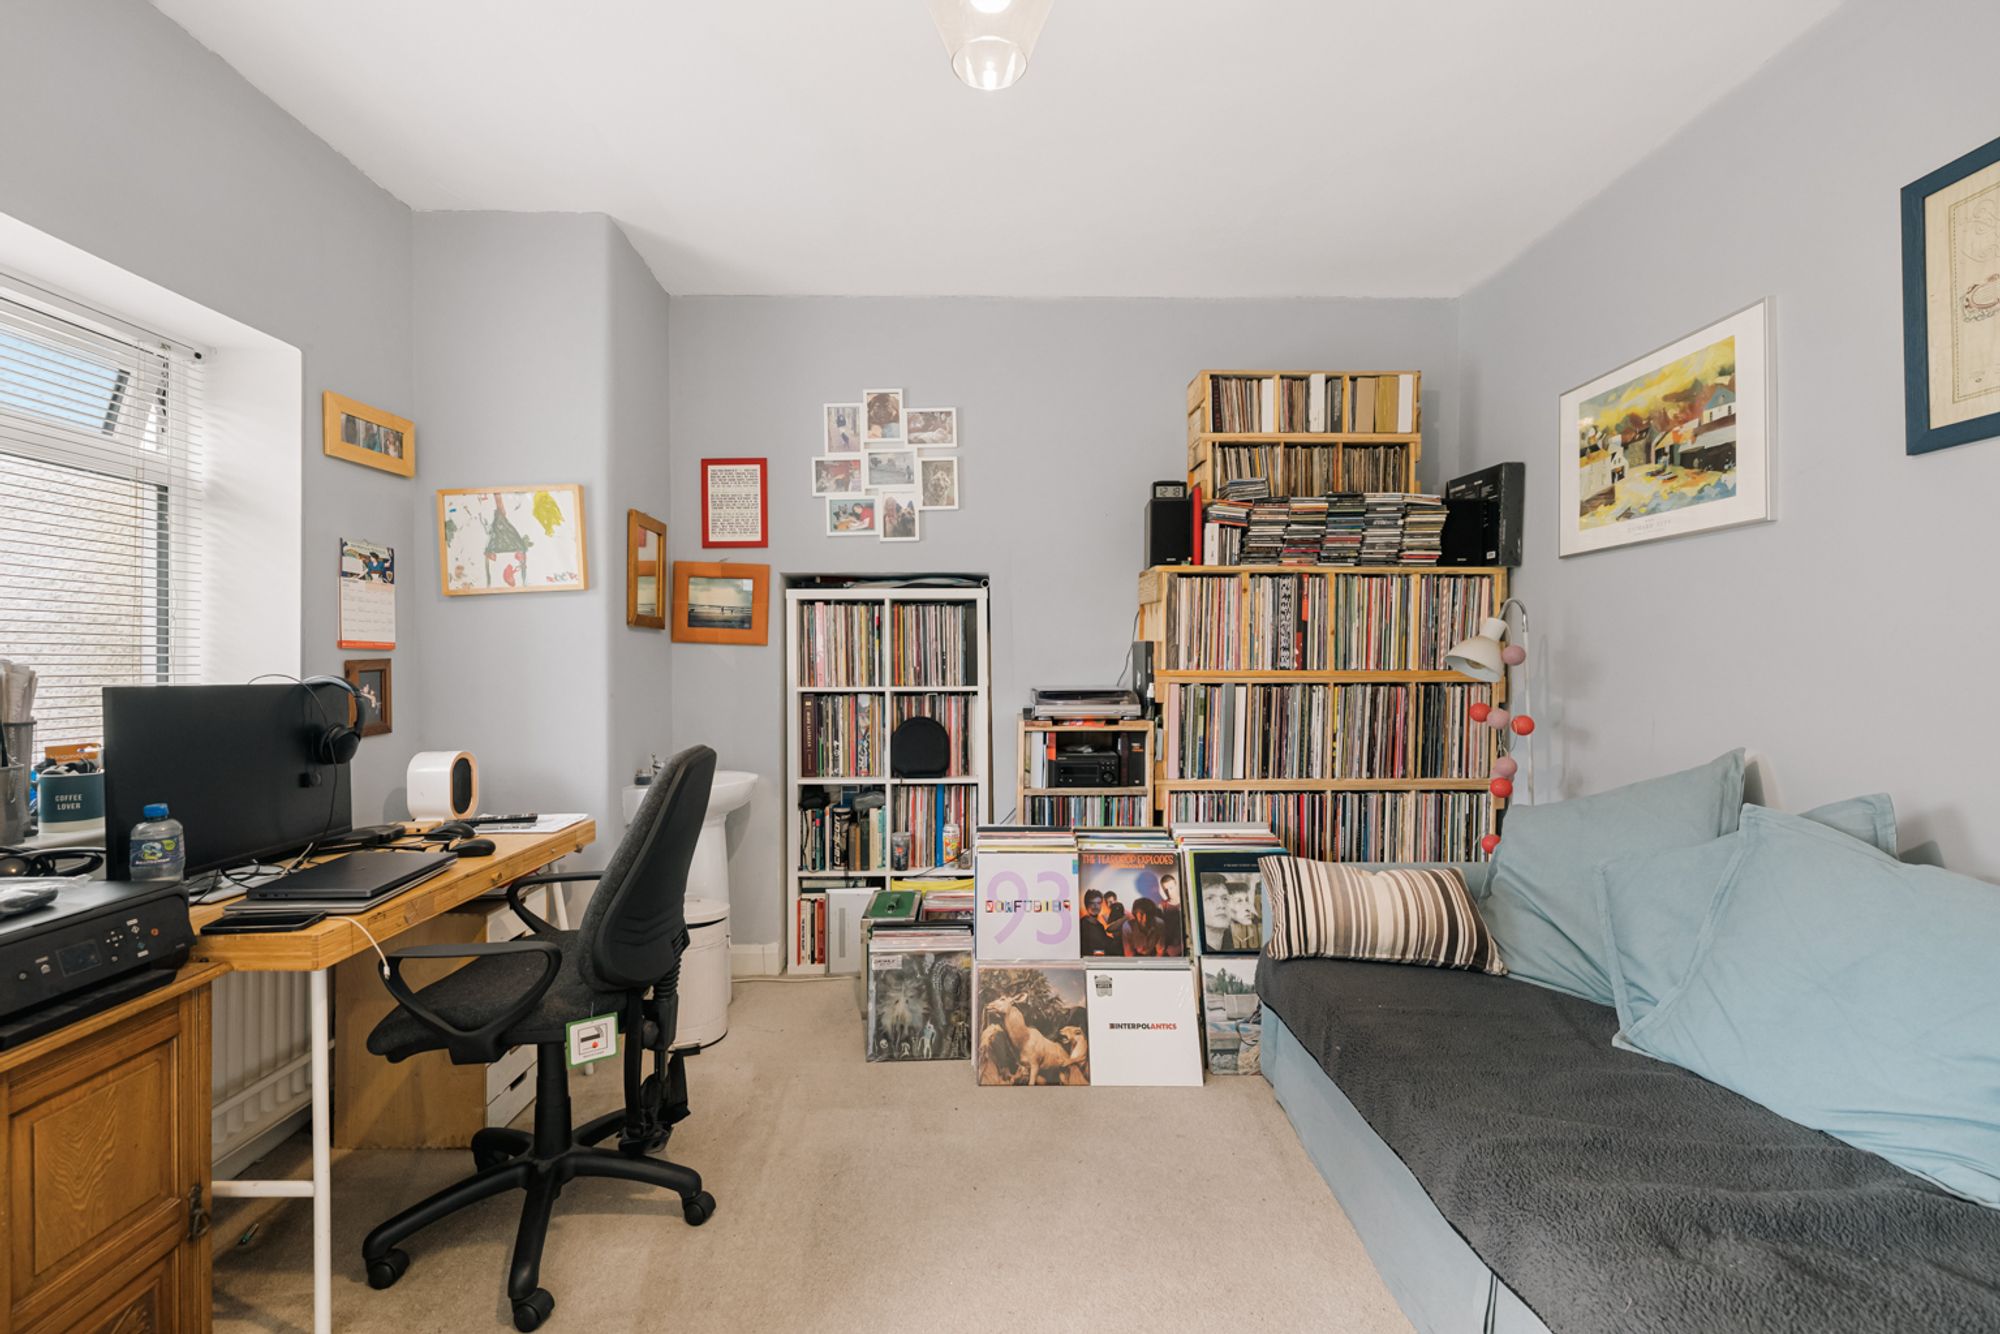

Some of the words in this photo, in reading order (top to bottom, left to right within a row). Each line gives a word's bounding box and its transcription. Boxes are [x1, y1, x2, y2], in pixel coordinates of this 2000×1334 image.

[54, 794, 83, 802] COFFEE
[57, 802, 81, 811] LOVER
[1082, 854, 1096, 864] THE
[1097, 854, 1136, 864] TEARDROP
[1137, 854, 1174, 865] EXPLODES
[986, 870, 1073, 945] 93
